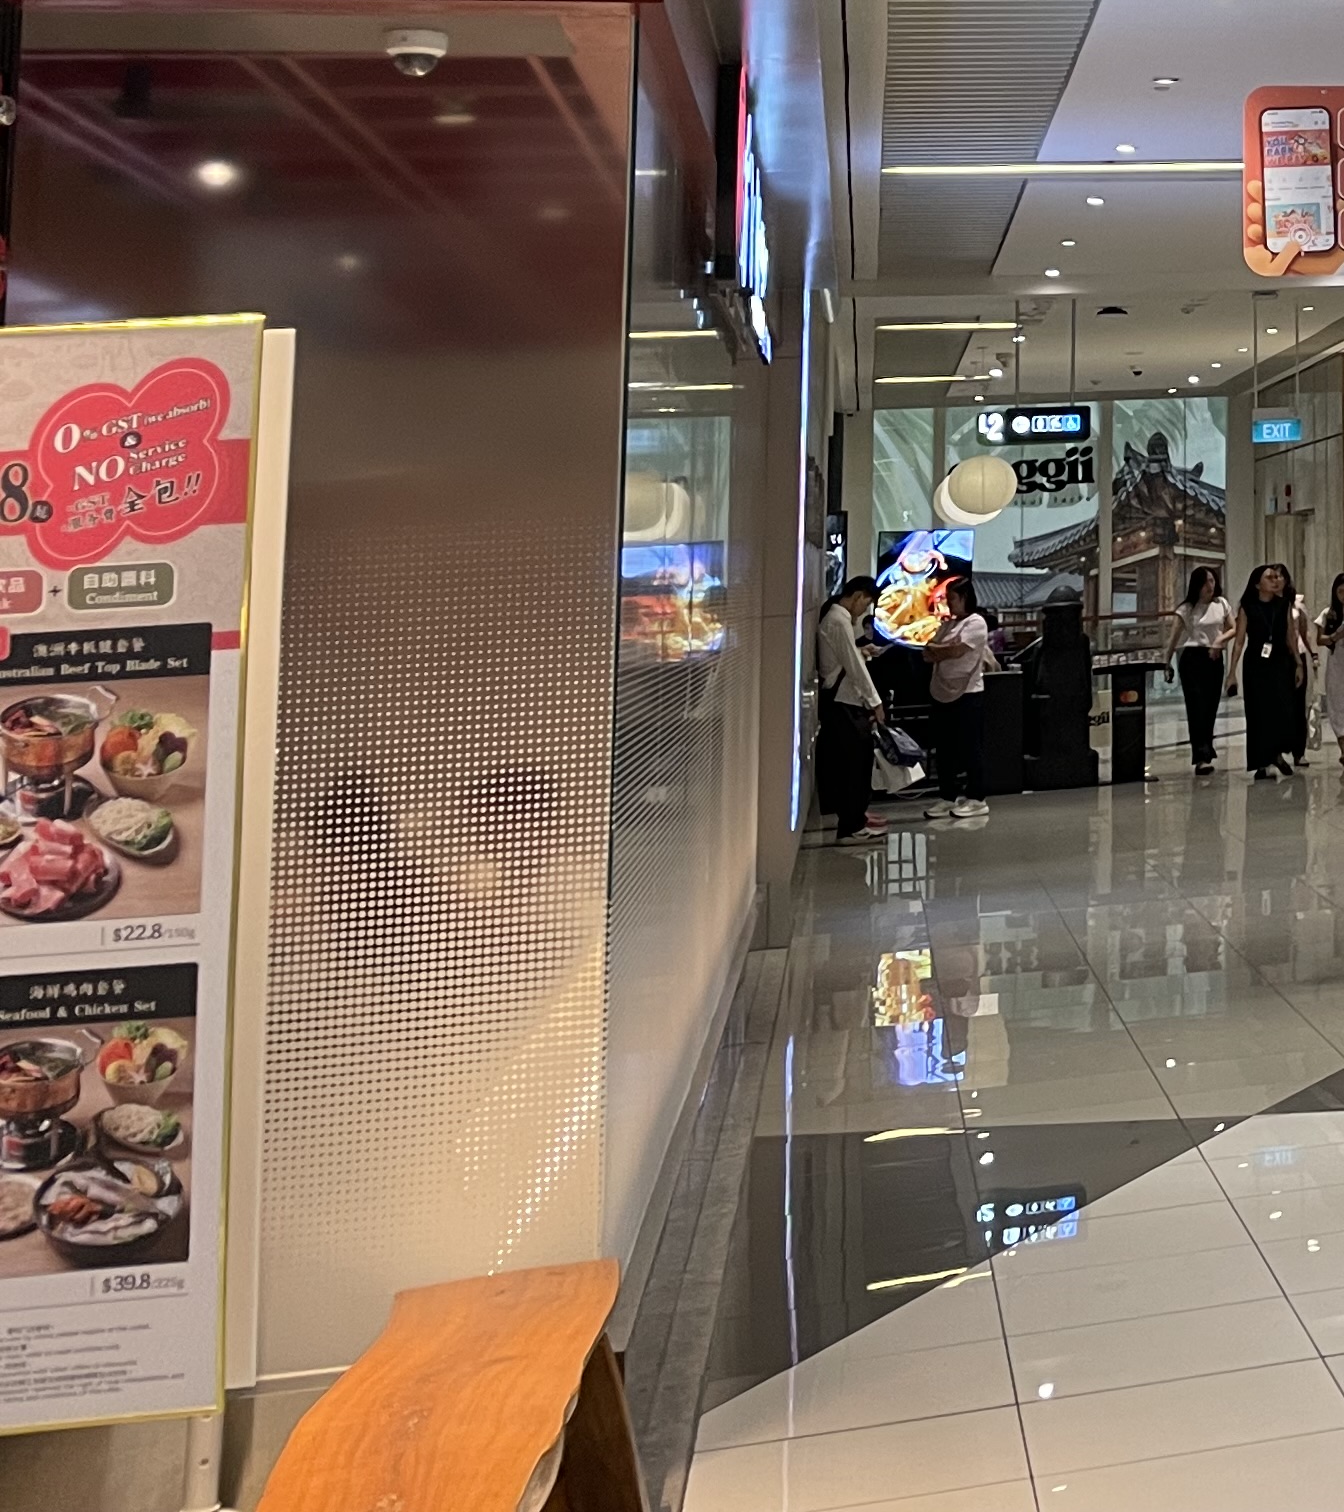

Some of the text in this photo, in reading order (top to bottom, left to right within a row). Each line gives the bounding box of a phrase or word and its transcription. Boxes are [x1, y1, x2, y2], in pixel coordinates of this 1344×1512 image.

[101, 412, 142, 437] GST
[978, 413, 1004, 441] L2
[1262, 422, 1292, 439] EXIT
[129, 439, 187, 461] Service
[73, 455, 125, 491] NO
[129, 453, 187, 476] Charge
[85, 590, 158, 605] Condiment
[60, 662, 91, 676] Beef
[95, 661, 121, 675] Top
[167, 656, 189, 669] Set
[75, 1001, 129, 1018] Chicken
[134, 999, 157, 1013] Set
